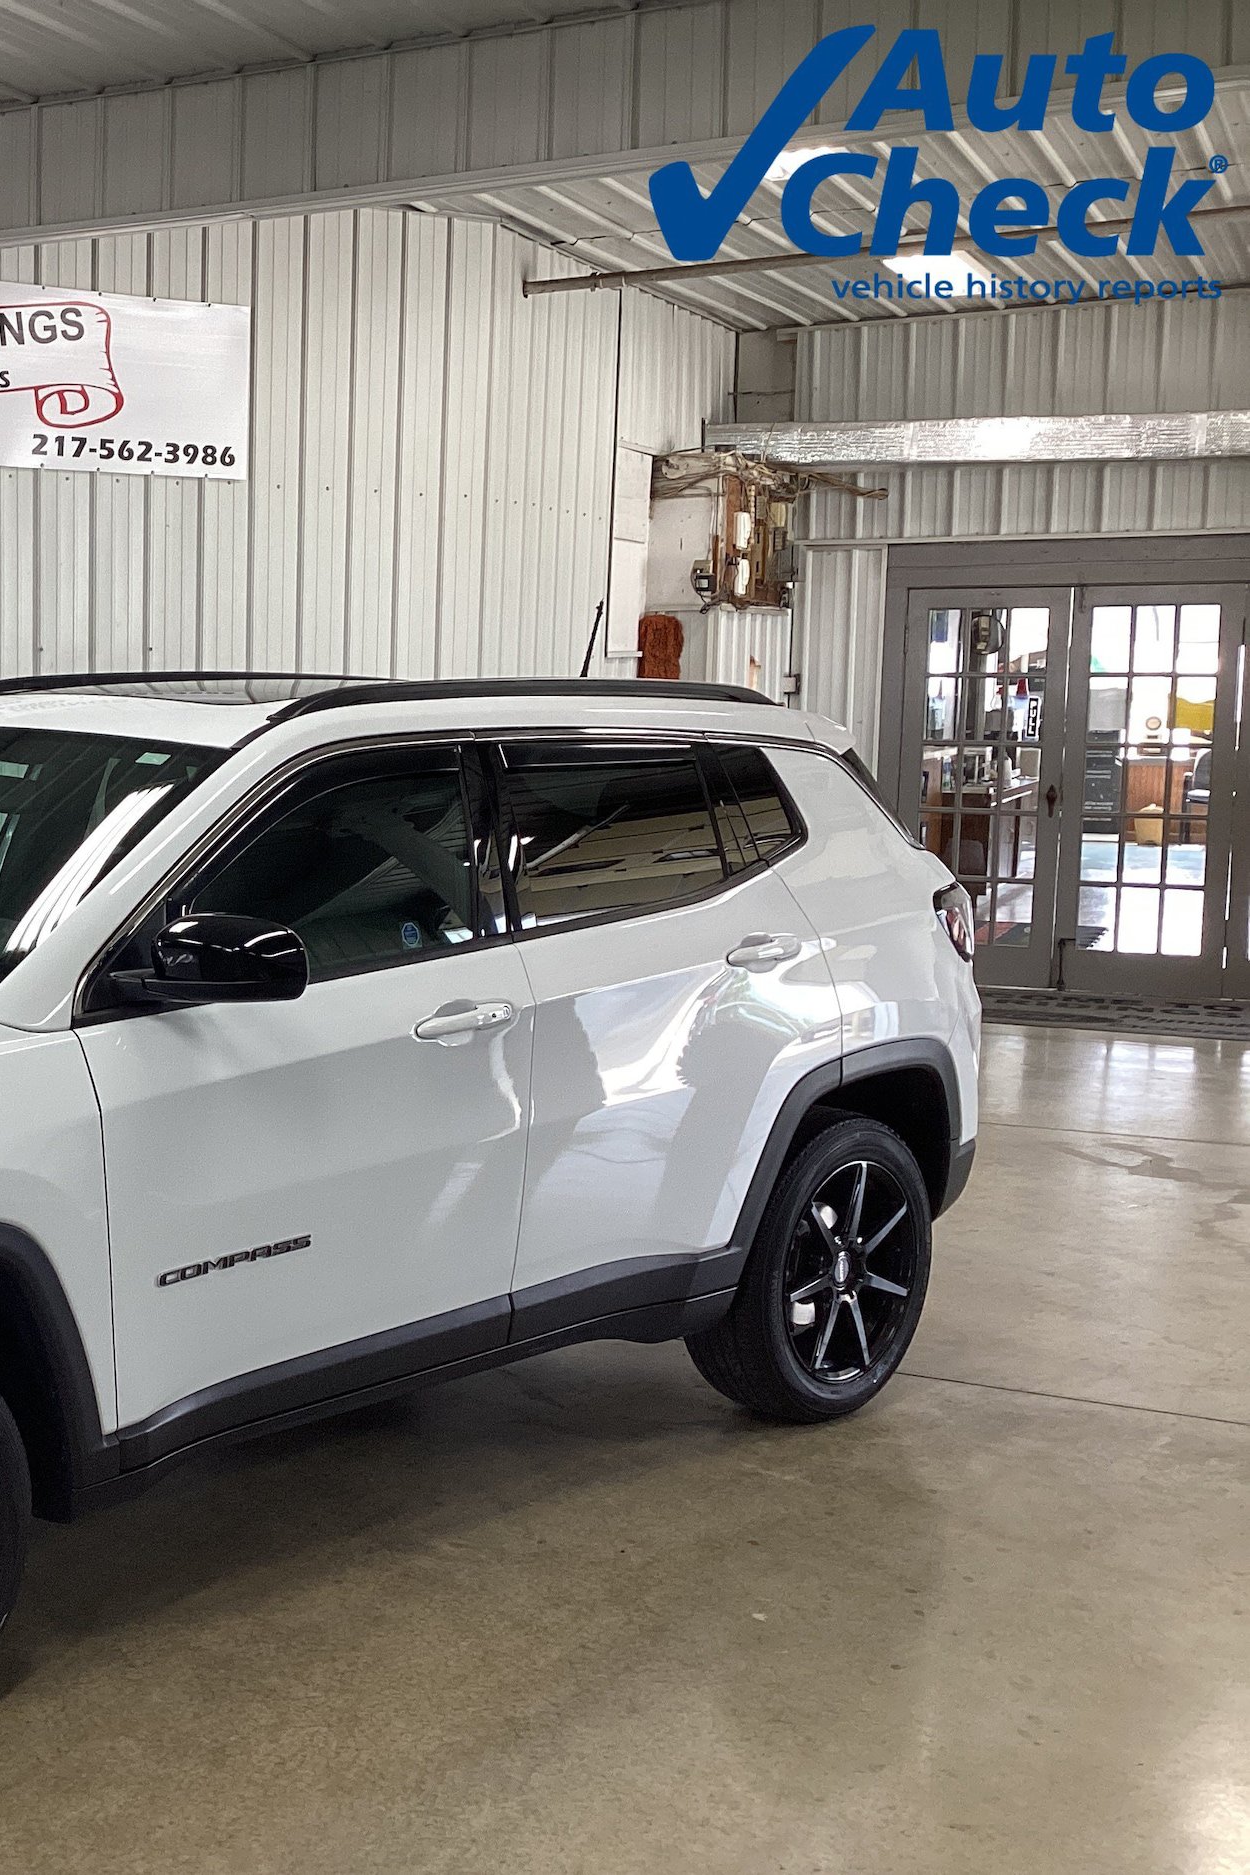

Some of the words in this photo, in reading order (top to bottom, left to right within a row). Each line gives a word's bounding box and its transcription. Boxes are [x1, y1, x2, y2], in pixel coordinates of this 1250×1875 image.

[31, 433, 236, 467] 217-562-3986
[1028, 700, 1038, 734] PULL
[158, 1233, 312, 1287] COMPASS
